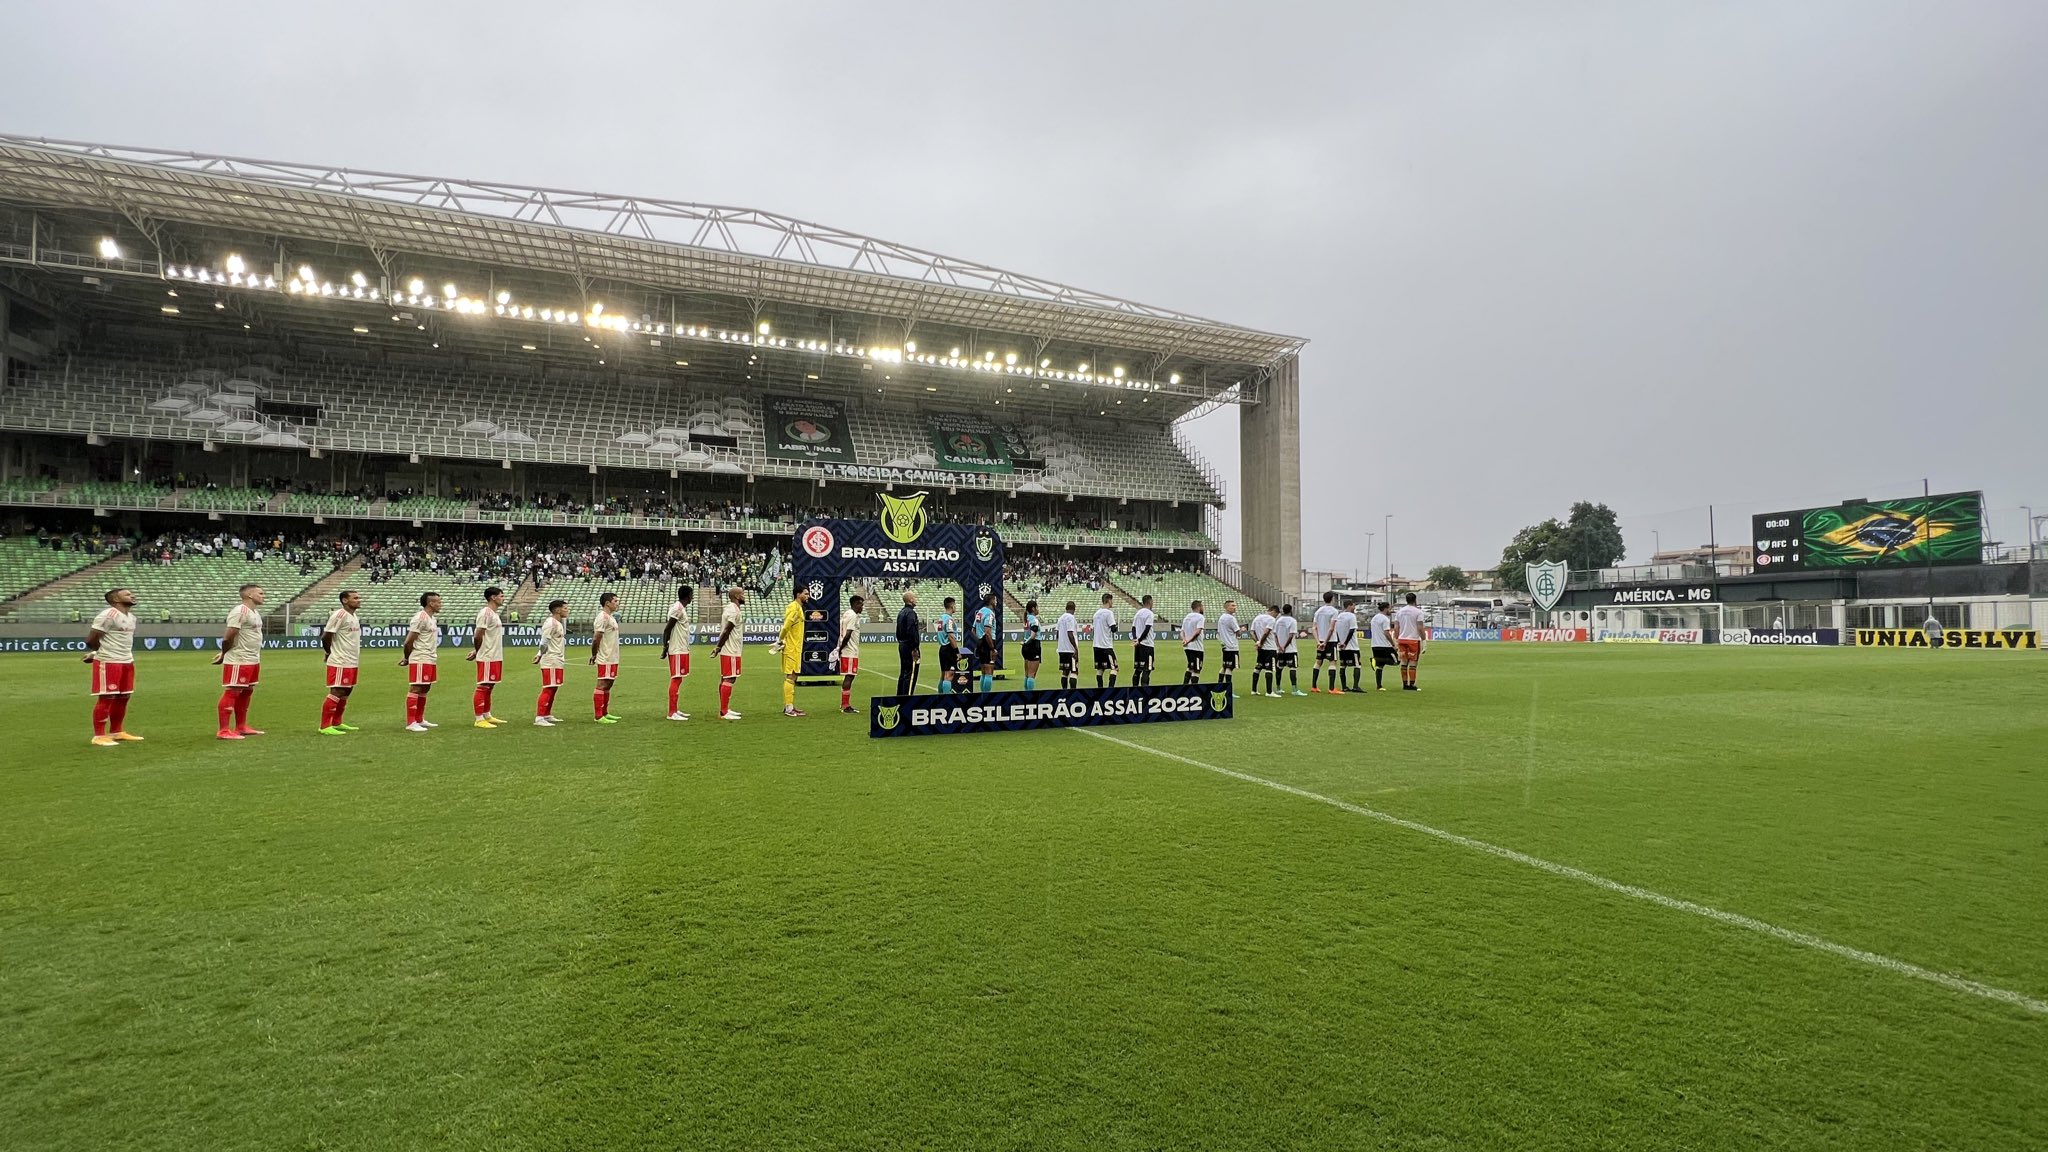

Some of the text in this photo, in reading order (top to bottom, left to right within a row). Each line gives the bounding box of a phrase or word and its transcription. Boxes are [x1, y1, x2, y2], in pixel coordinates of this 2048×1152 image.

[837, 464, 901, 479] TORCIDA
[904, 469, 956, 482] CAMISA
[1765, 518, 1790, 529] 00:00
[1771, 538, 1799, 549] AFC 0
[841, 547, 960, 562] BRASILEIRÃO
[1771, 553, 1799, 563] INT 0
[883, 561, 920, 573] ASSAÍ
[1613, 587, 1675, 603] AMÉRICA
[1687, 588, 1712, 601] MG
[1432, 629, 1464, 641] pixbet
[1465, 629, 1499, 641] pixbet
[1521, 629, 1576, 642] BETANO
[1658, 630, 1698, 643] Fácil
[1722, 632, 1818, 644] bet nacional
[911, 696, 1203, 726] BRASILEIRÃO ASSAÍ 2022
